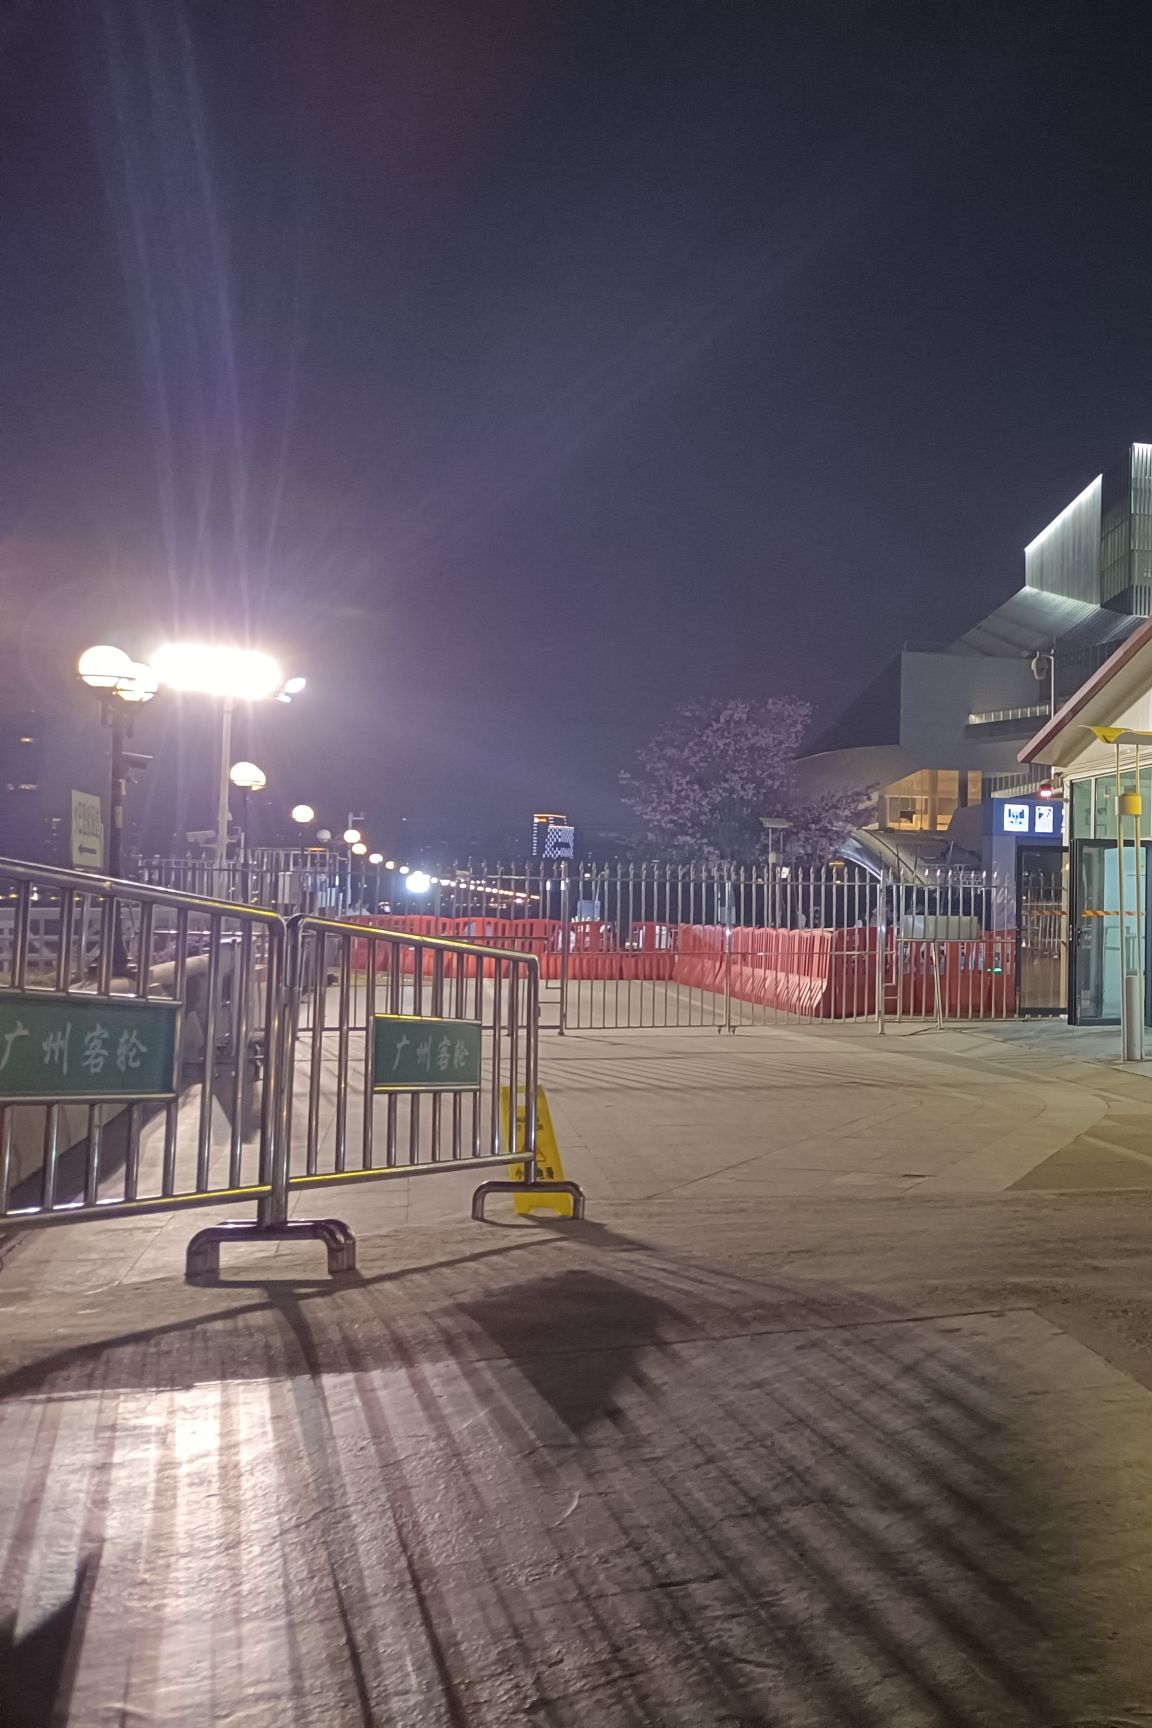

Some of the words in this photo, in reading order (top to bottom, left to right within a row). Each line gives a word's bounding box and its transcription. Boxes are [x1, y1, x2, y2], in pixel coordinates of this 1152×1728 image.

[0, 1010, 148, 1076] 广州客轮
[391, 1033, 470, 1073] 广州客轮
